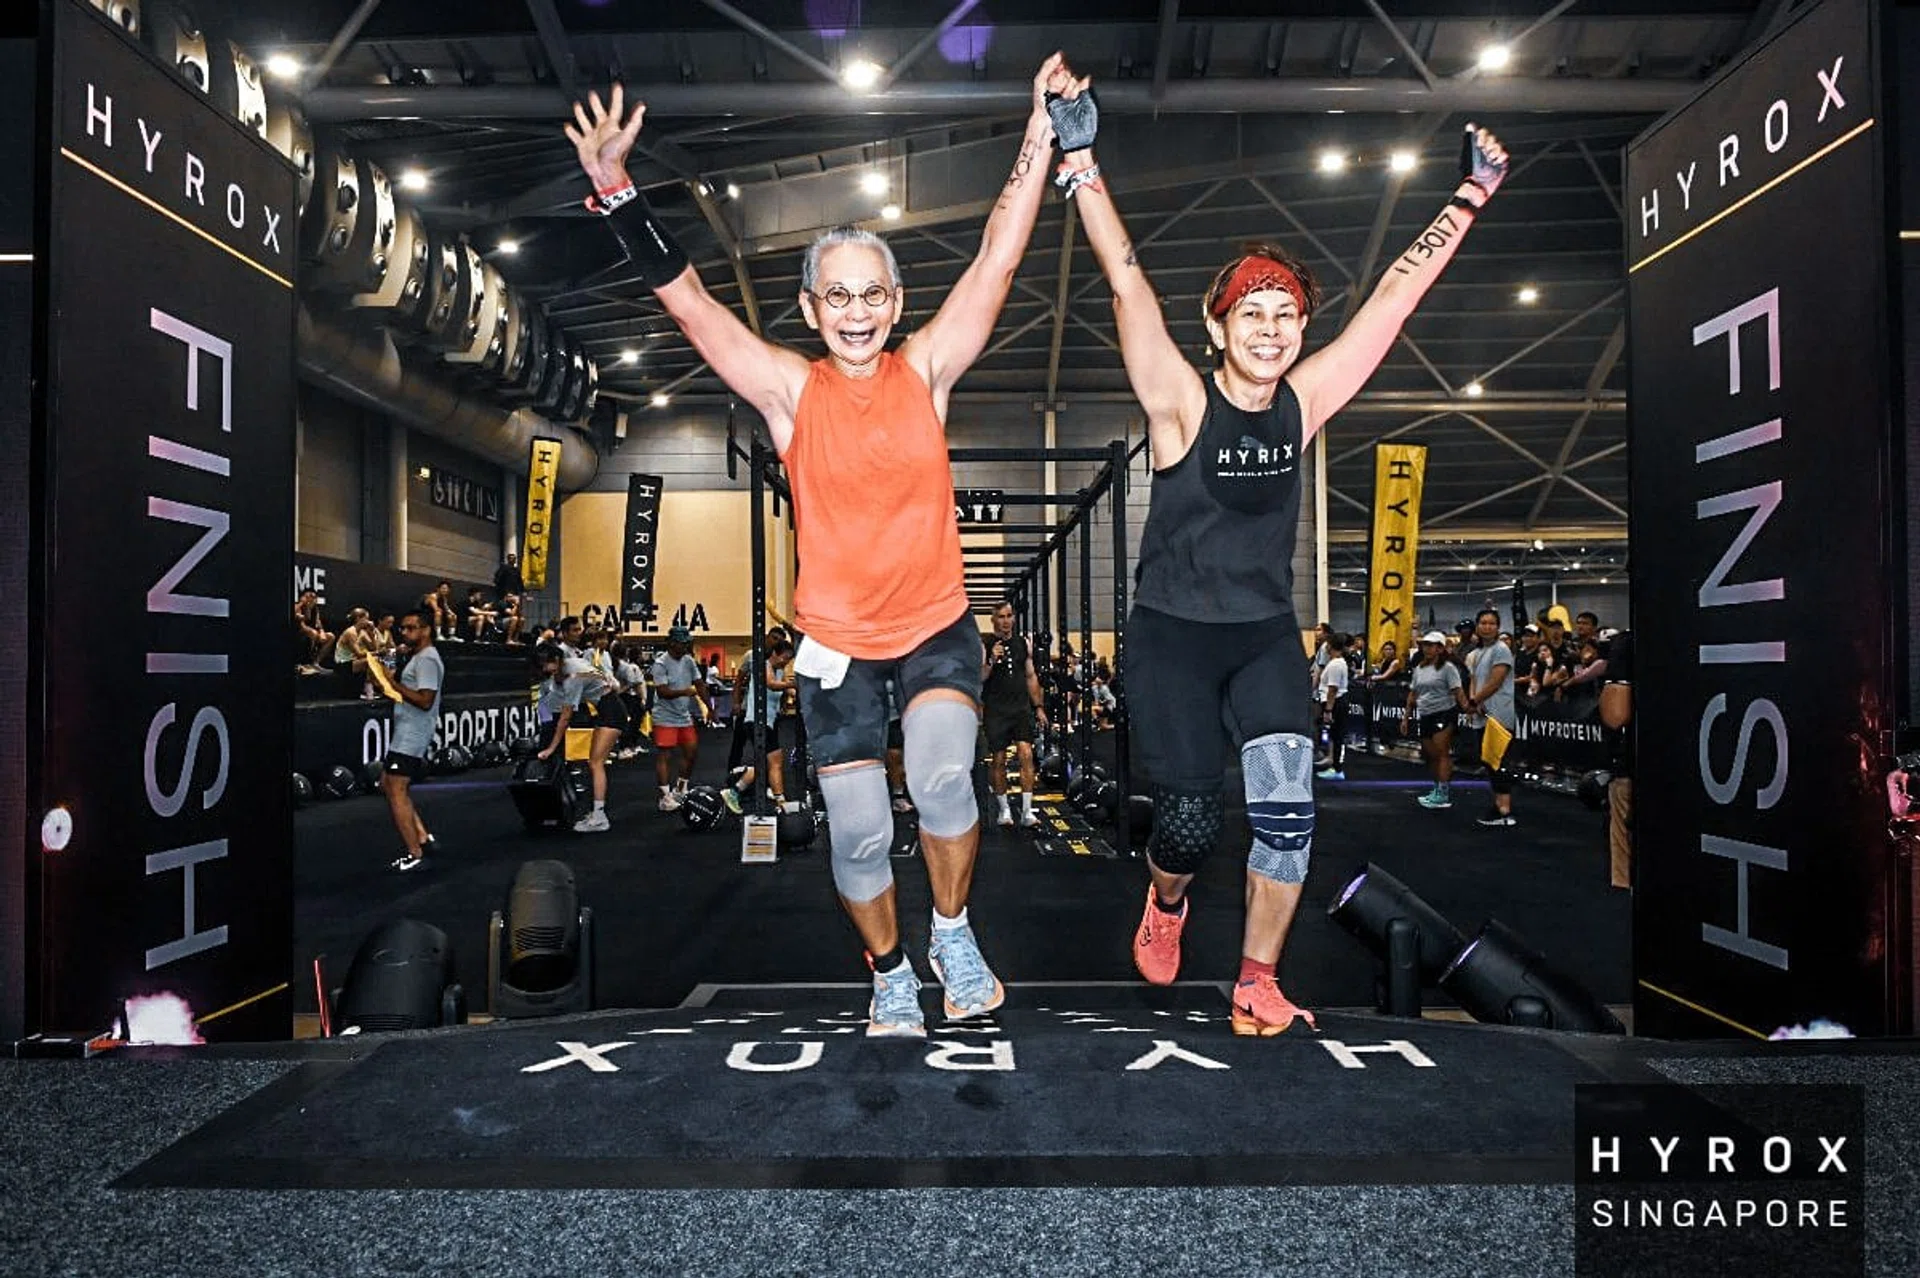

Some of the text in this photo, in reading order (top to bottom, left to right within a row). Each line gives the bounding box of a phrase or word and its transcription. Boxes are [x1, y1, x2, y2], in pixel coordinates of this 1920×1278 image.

[86, 83, 280, 255] HYROX
[1641, 56, 1846, 237] HYROX
[1394, 212, 1459, 275] 113017
[529, 450, 552, 558] HYROX
[631, 484, 656, 590] HYROX
[1380, 460, 1411, 626] HYROX
[144, 306, 233, 970] FINISH
[1693, 286, 1788, 970] FINISH
[1531, 719, 1602, 742] MYPROTEIN
[519, 1040, 1437, 1074] HYROX
